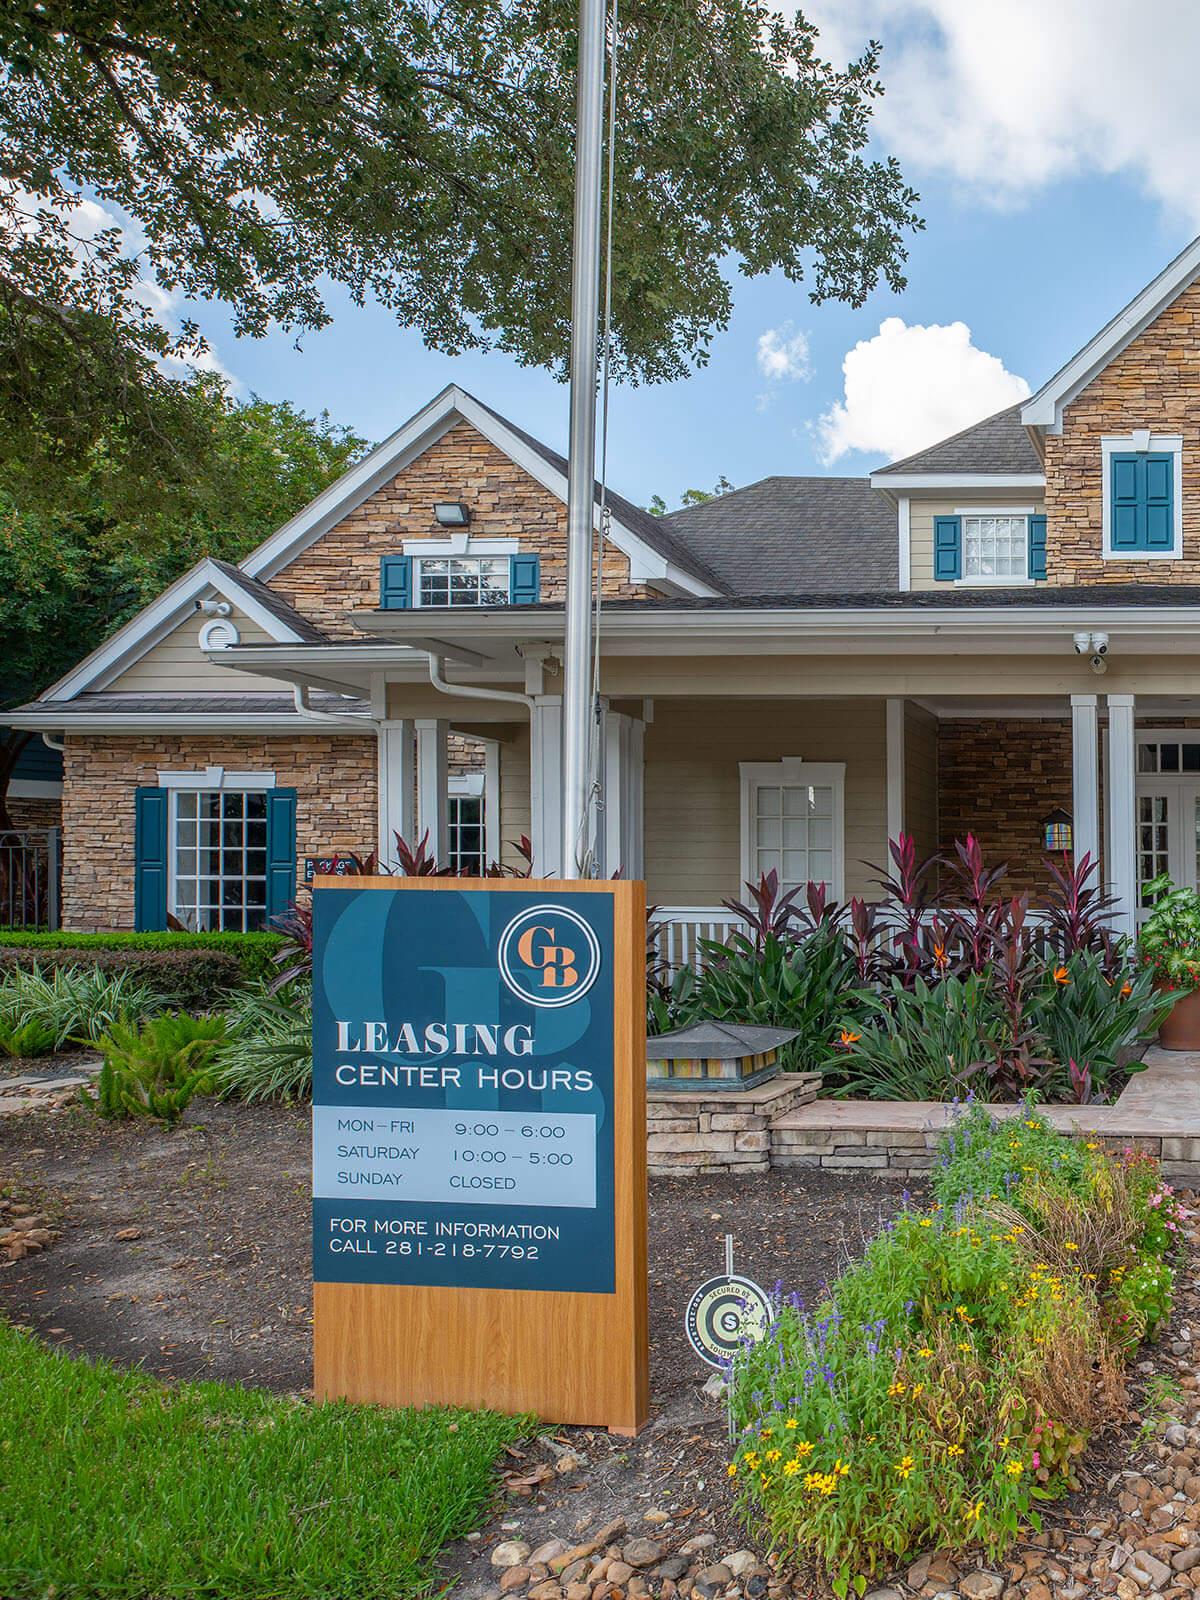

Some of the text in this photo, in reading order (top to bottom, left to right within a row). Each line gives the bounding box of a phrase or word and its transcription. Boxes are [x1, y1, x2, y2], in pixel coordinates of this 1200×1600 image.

[518, 925, 578, 987] GB
[335, 1021, 536, 1056] LEASING
[335, 1064, 593, 1091] CENTER HOURS
[455, 1123, 498, 1136] 9:00
[521, 1126, 565, 1138] 6:00
[337, 1145, 419, 1159] SATURDAY
[454, 1150, 506, 1163] 10:00
[529, 1153, 573, 1165] 5:00
[337, 1171, 516, 1189] SUNDAY CLOSED
[330, 1218, 559, 1240] FOR MORE INFORMATION
[329, 1238, 539, 1259] CALL 281-218-7792
[709, 1286, 740, 1299] SECURED
